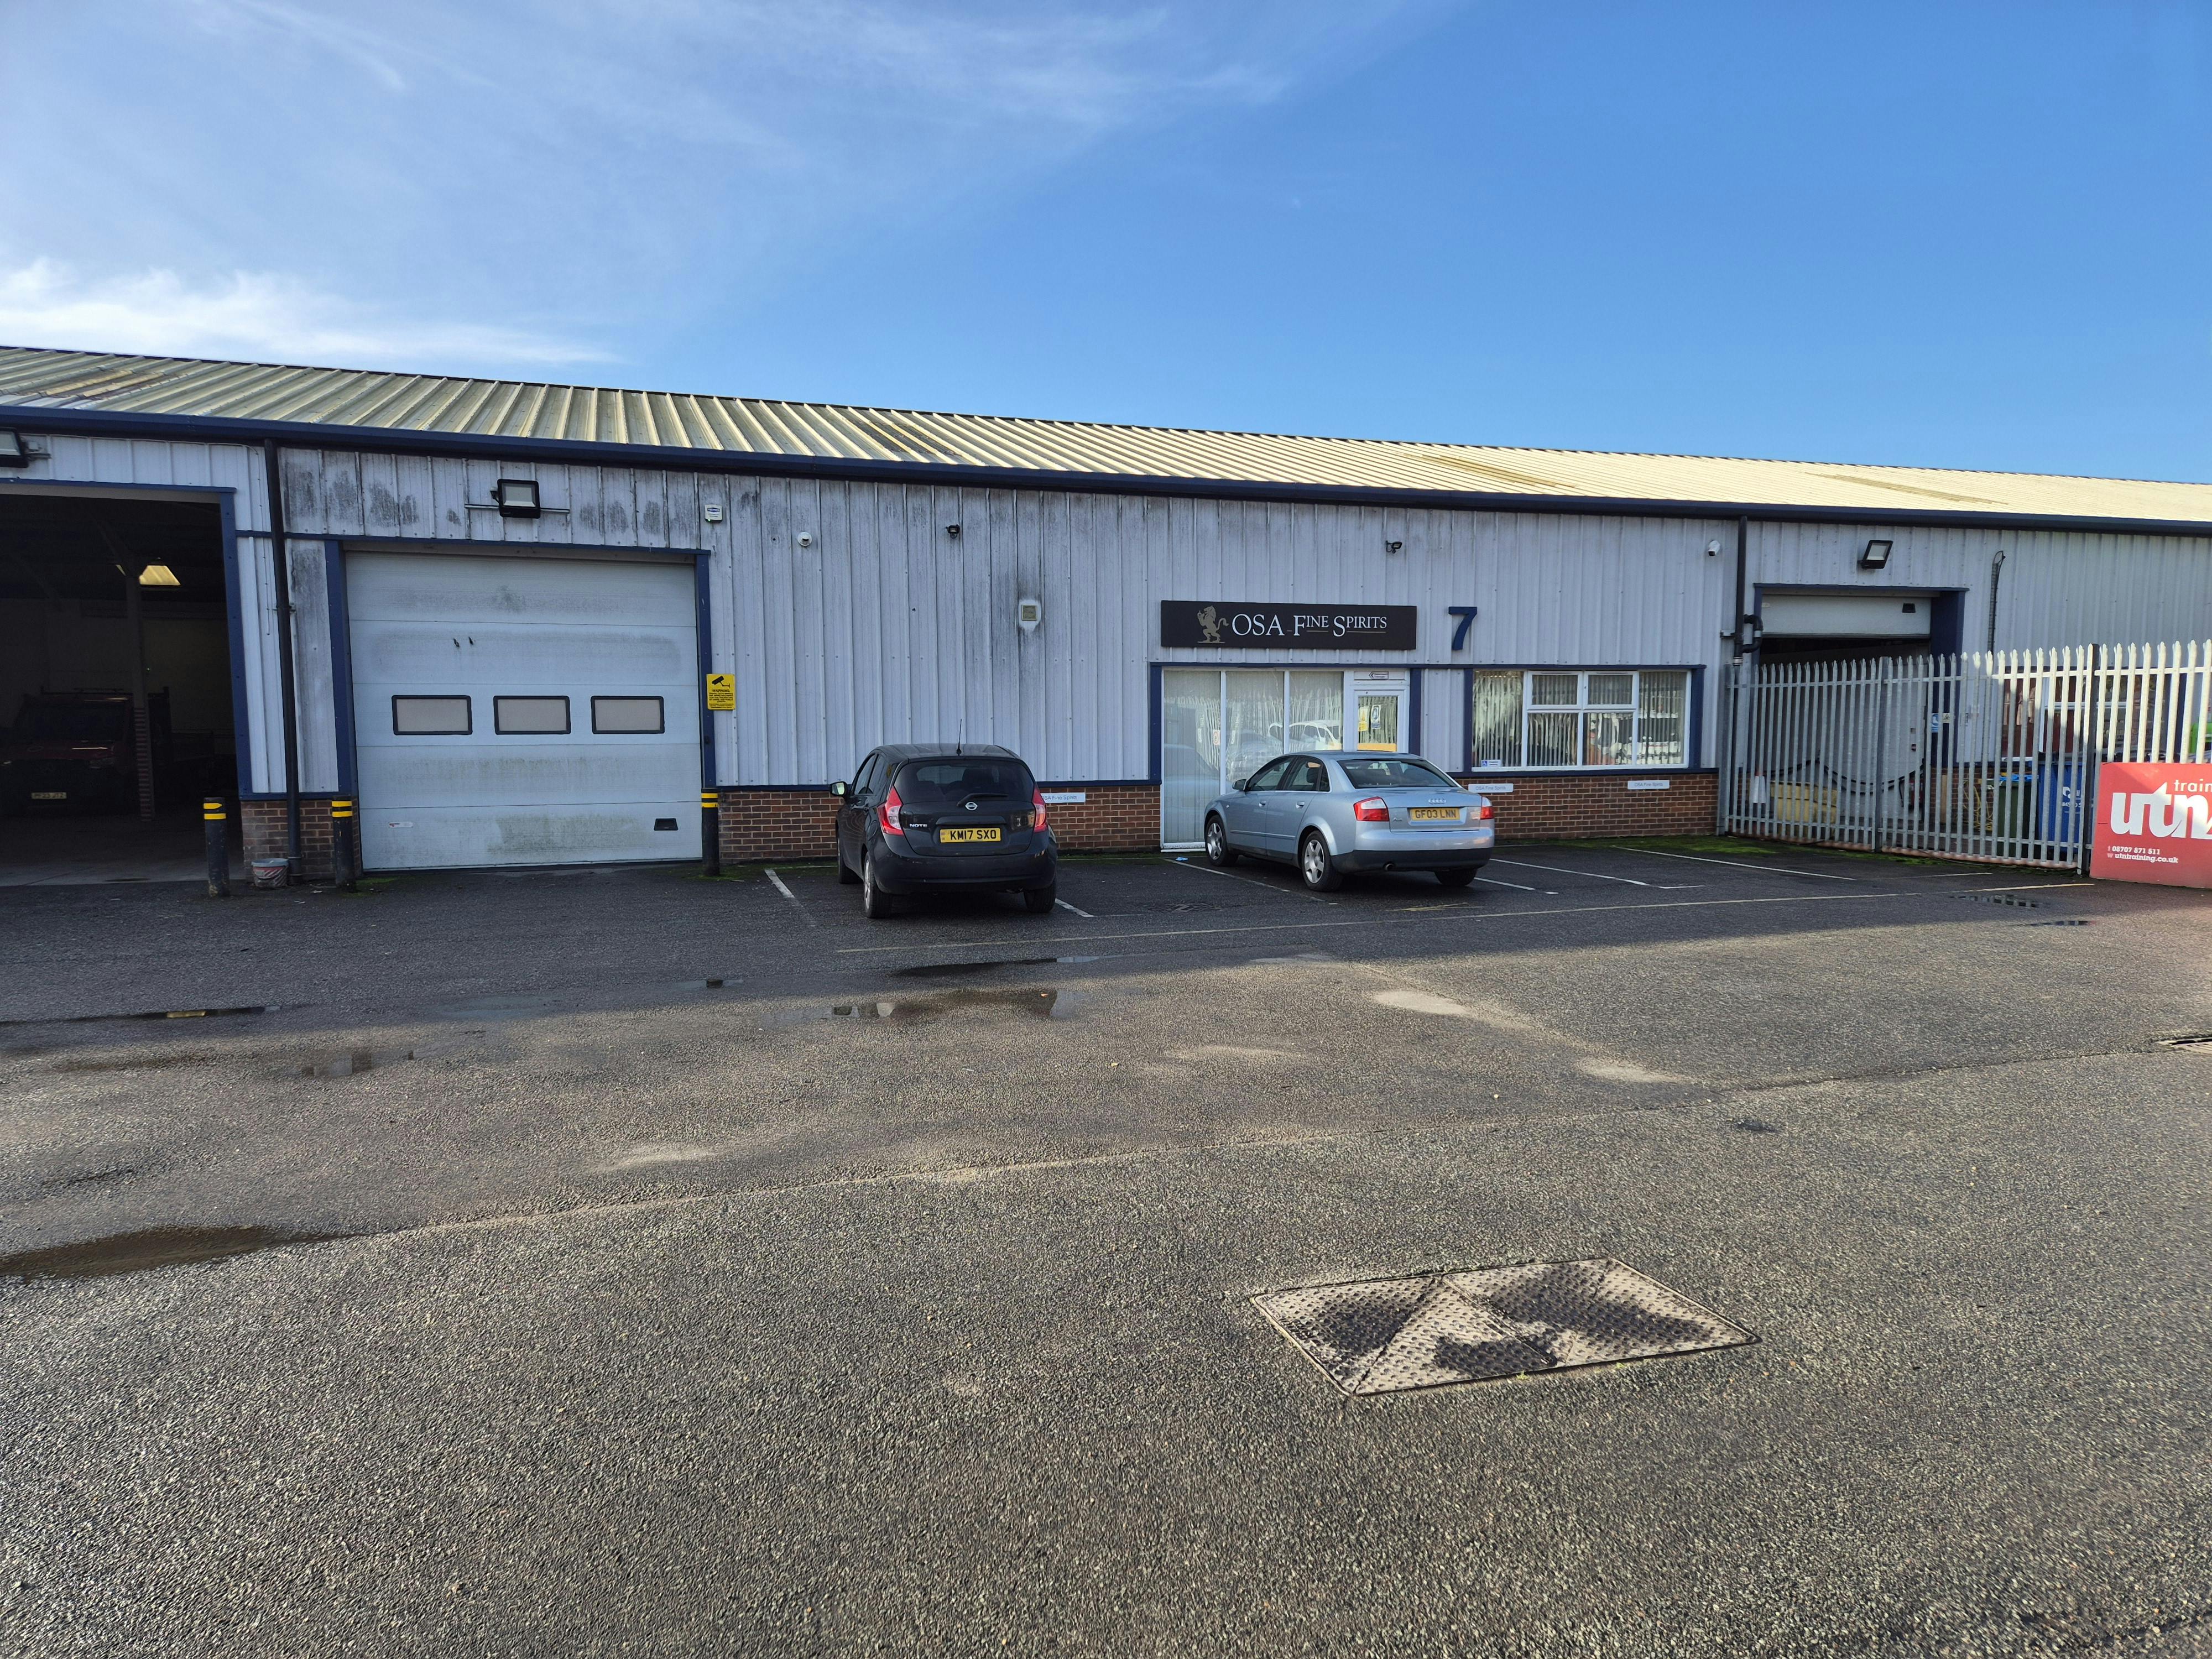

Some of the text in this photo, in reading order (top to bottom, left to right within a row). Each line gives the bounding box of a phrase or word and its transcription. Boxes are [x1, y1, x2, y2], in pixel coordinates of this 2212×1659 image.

[1232, 613, 1387, 637] OSA FINE SPIRITS
[1448, 606, 1477, 650] 7
[1415, 809, 1456, 818] GF03 LNN
[950, 830, 974, 840] KM17
[977, 830, 997, 839] SXO
[2115, 853, 2179, 863] utntraining.co.uk
